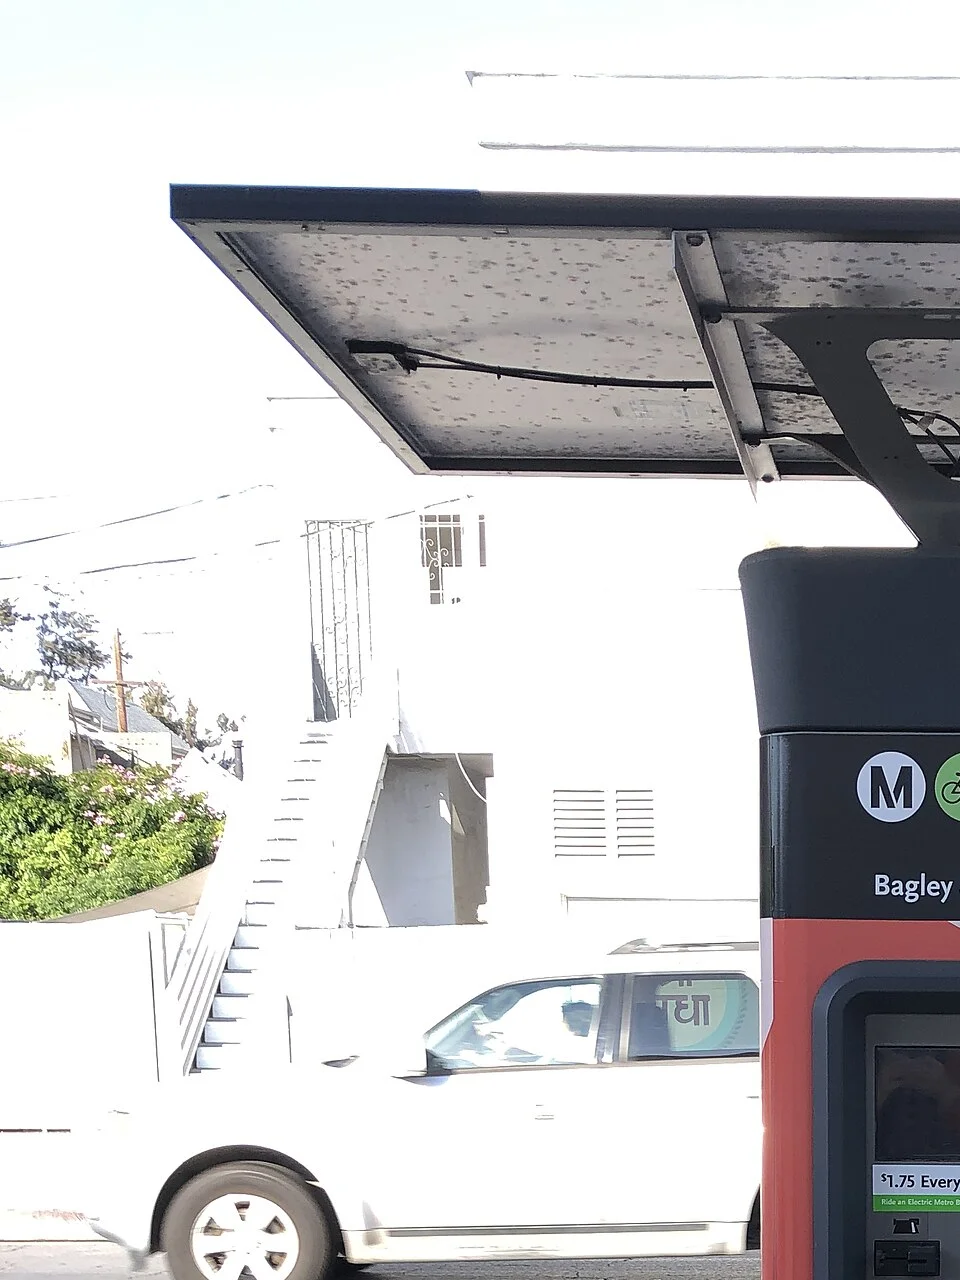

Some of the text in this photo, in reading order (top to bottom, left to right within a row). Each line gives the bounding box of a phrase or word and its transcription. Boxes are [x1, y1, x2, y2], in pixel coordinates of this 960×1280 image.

[870, 766, 912, 808] M
[874, 874, 954, 903] Bagley
[881, 1174, 915, 1188] $1.75
[921, 1175, 960, 1191] Every
